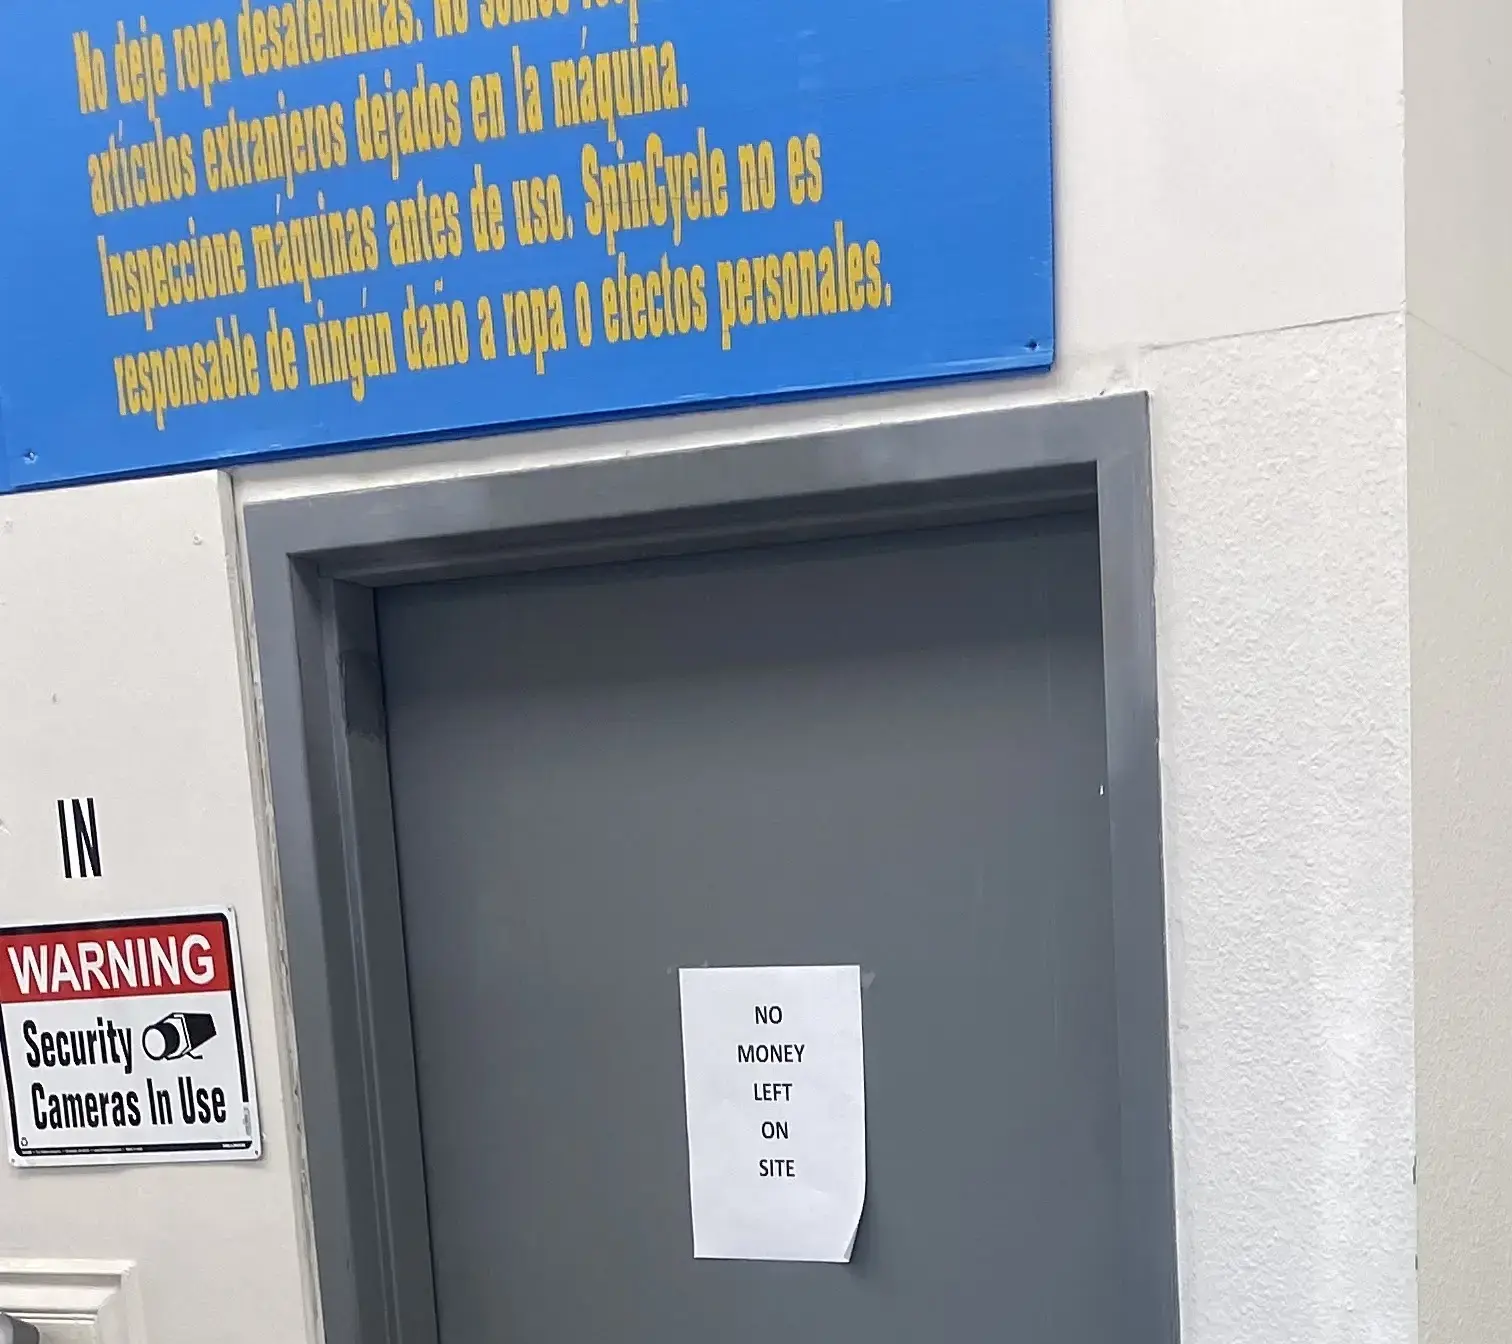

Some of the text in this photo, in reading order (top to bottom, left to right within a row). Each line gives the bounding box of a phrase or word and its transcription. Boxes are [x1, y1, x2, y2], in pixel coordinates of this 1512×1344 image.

[74, 32, 108, 114] No
[115, 16, 166, 120] deje
[173, 18, 231, 107] ropa
[238, 0, 423, 77] desatendidas.
[88, 26, 688, 215] artículos extranjeros dejados en la máquina.
[98, 128, 823, 330] Inspeccione máquinas antes de uso. SpinCycle no es
[114, 221, 892, 430] responsable de ningún daño a ropa o efectos personales.
[57, 798, 102, 878] IN
[7, 933, 215, 996] WARNING
[755, 1005, 783, 1025] NO
[22, 1016, 133, 1075] Security
[737, 1043, 806, 1064] MONEY
[31, 1082, 142, 1131] Cameras
[147, 1077, 173, 1126] In
[177, 1076, 228, 1125] Use
[753, 1082, 793, 1102] LEFT
[761, 1121, 789, 1140] ON
[759, 1158, 796, 1178] SITE
